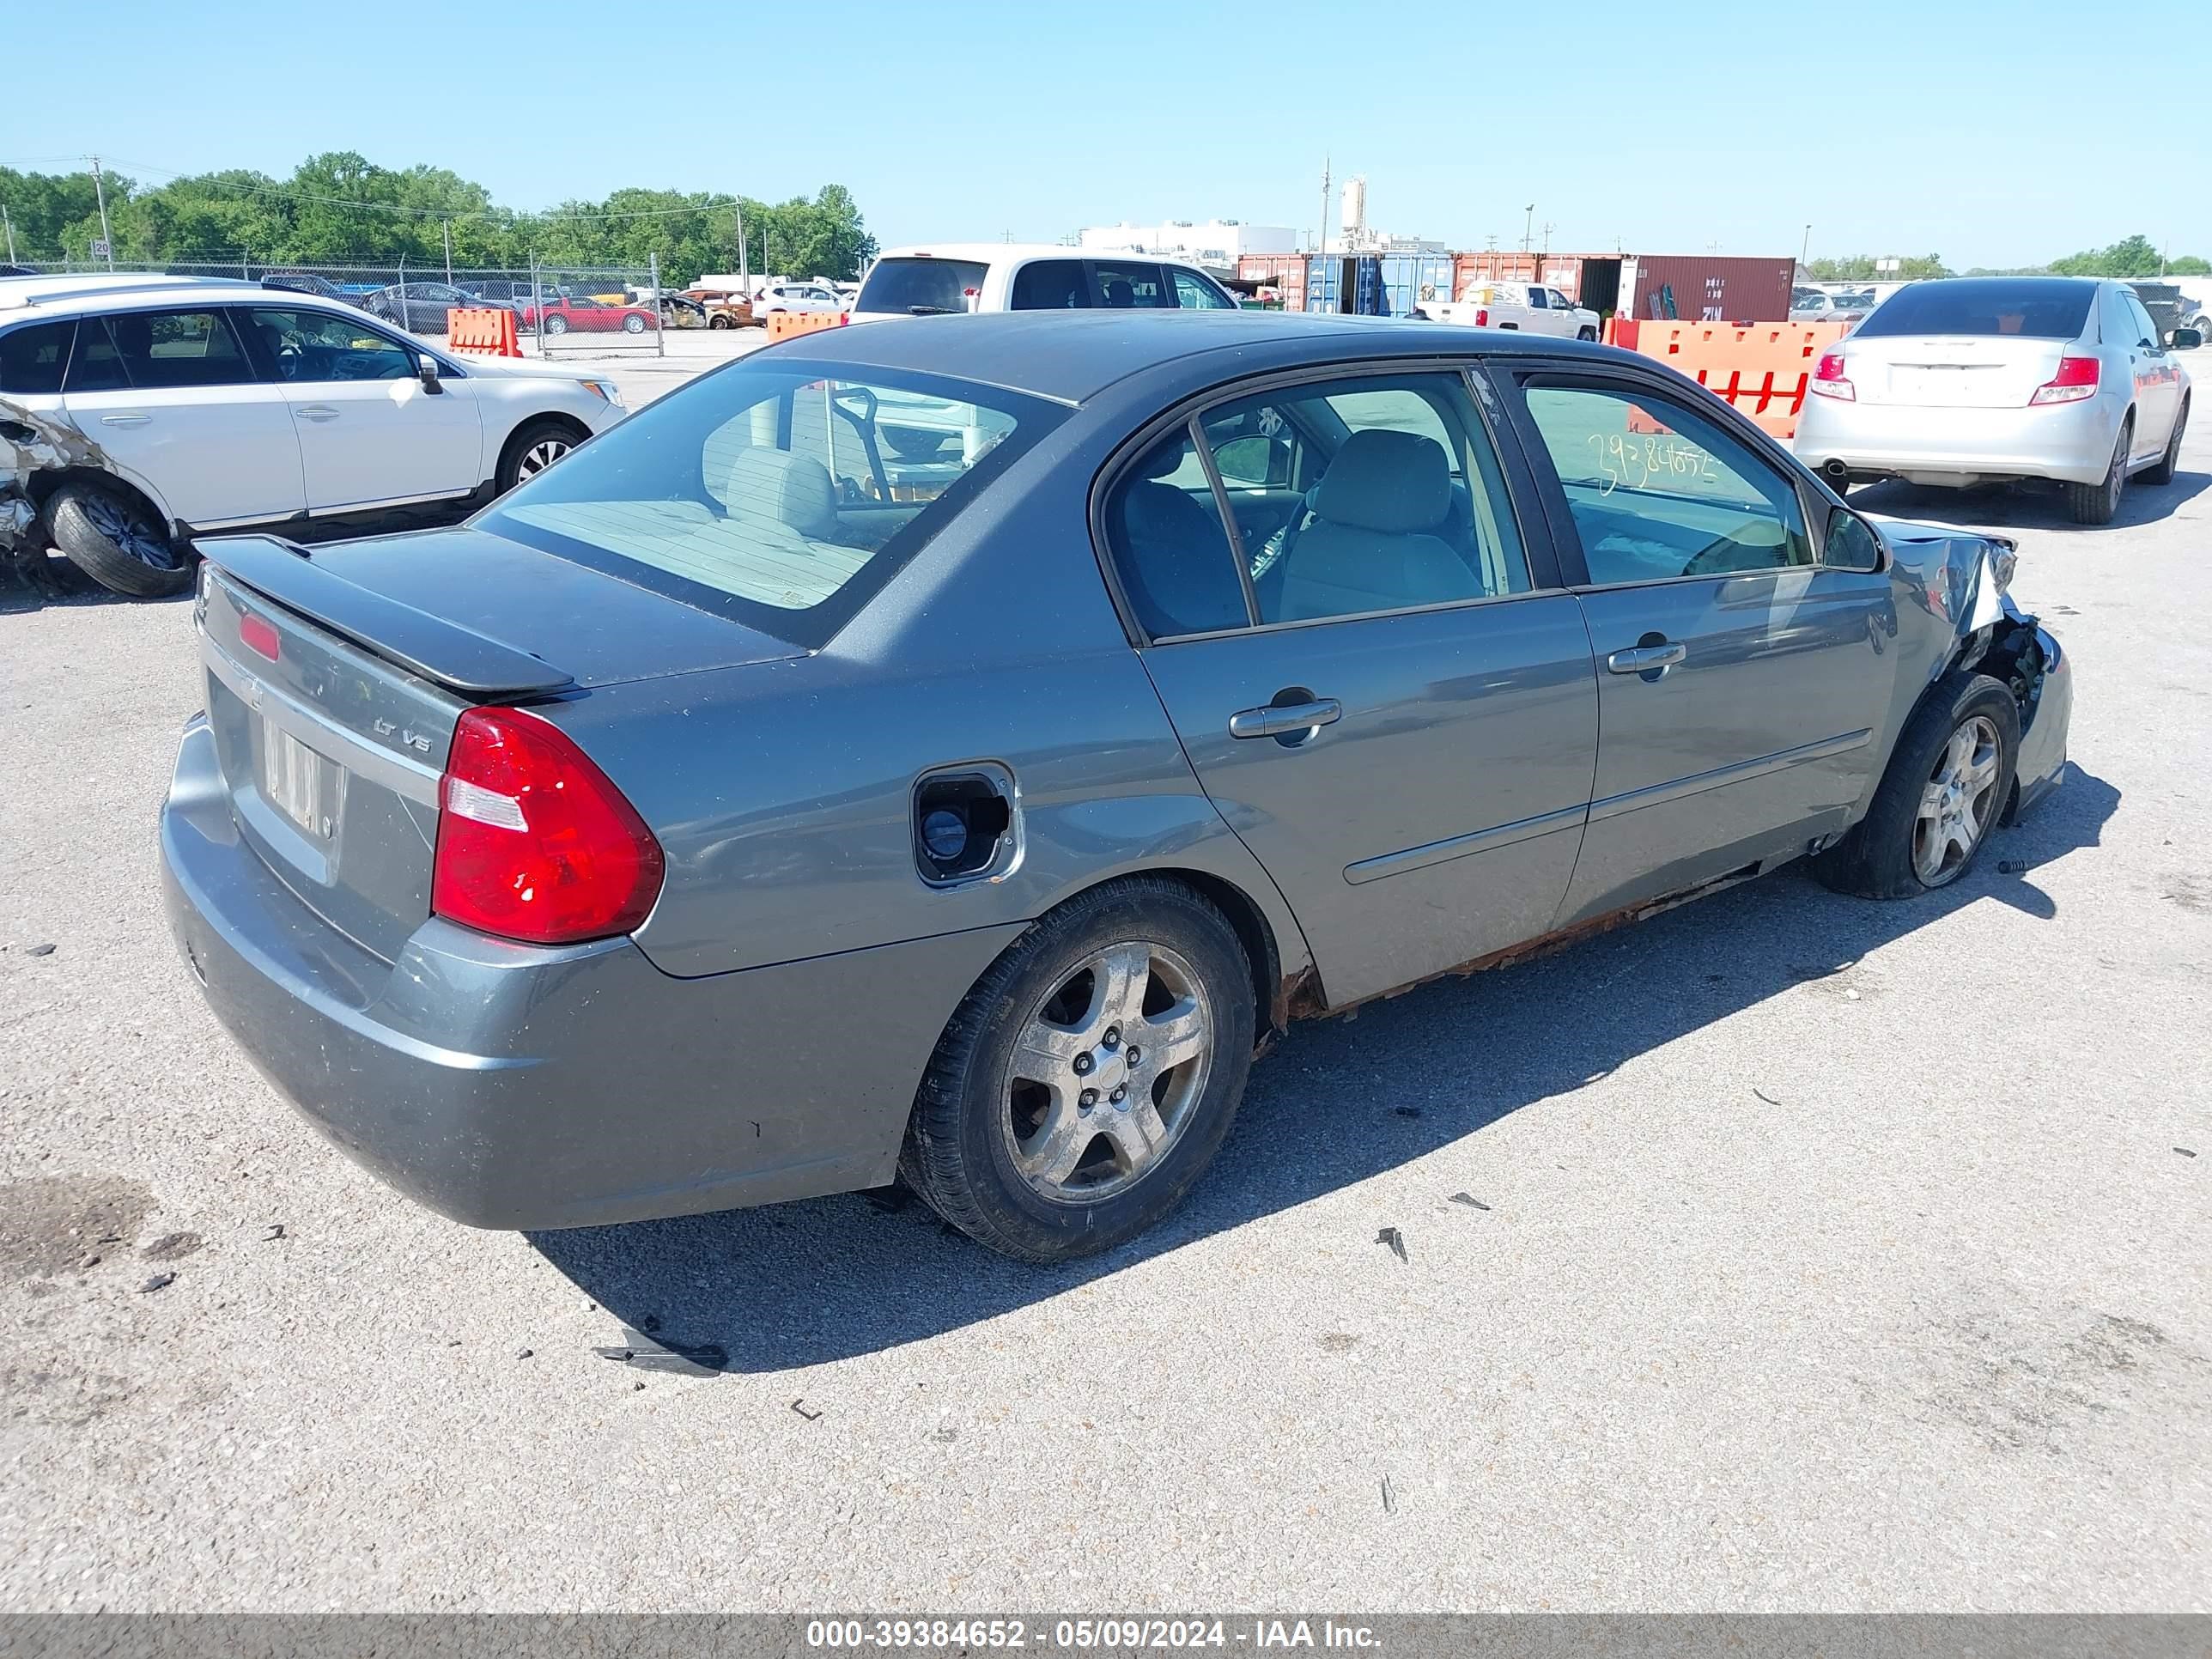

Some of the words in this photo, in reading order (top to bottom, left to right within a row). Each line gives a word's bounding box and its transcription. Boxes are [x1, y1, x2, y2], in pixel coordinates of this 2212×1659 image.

[95, 243, 108, 252] 20
[373, 718, 397, 736] LT
[403, 728, 433, 753] V6
